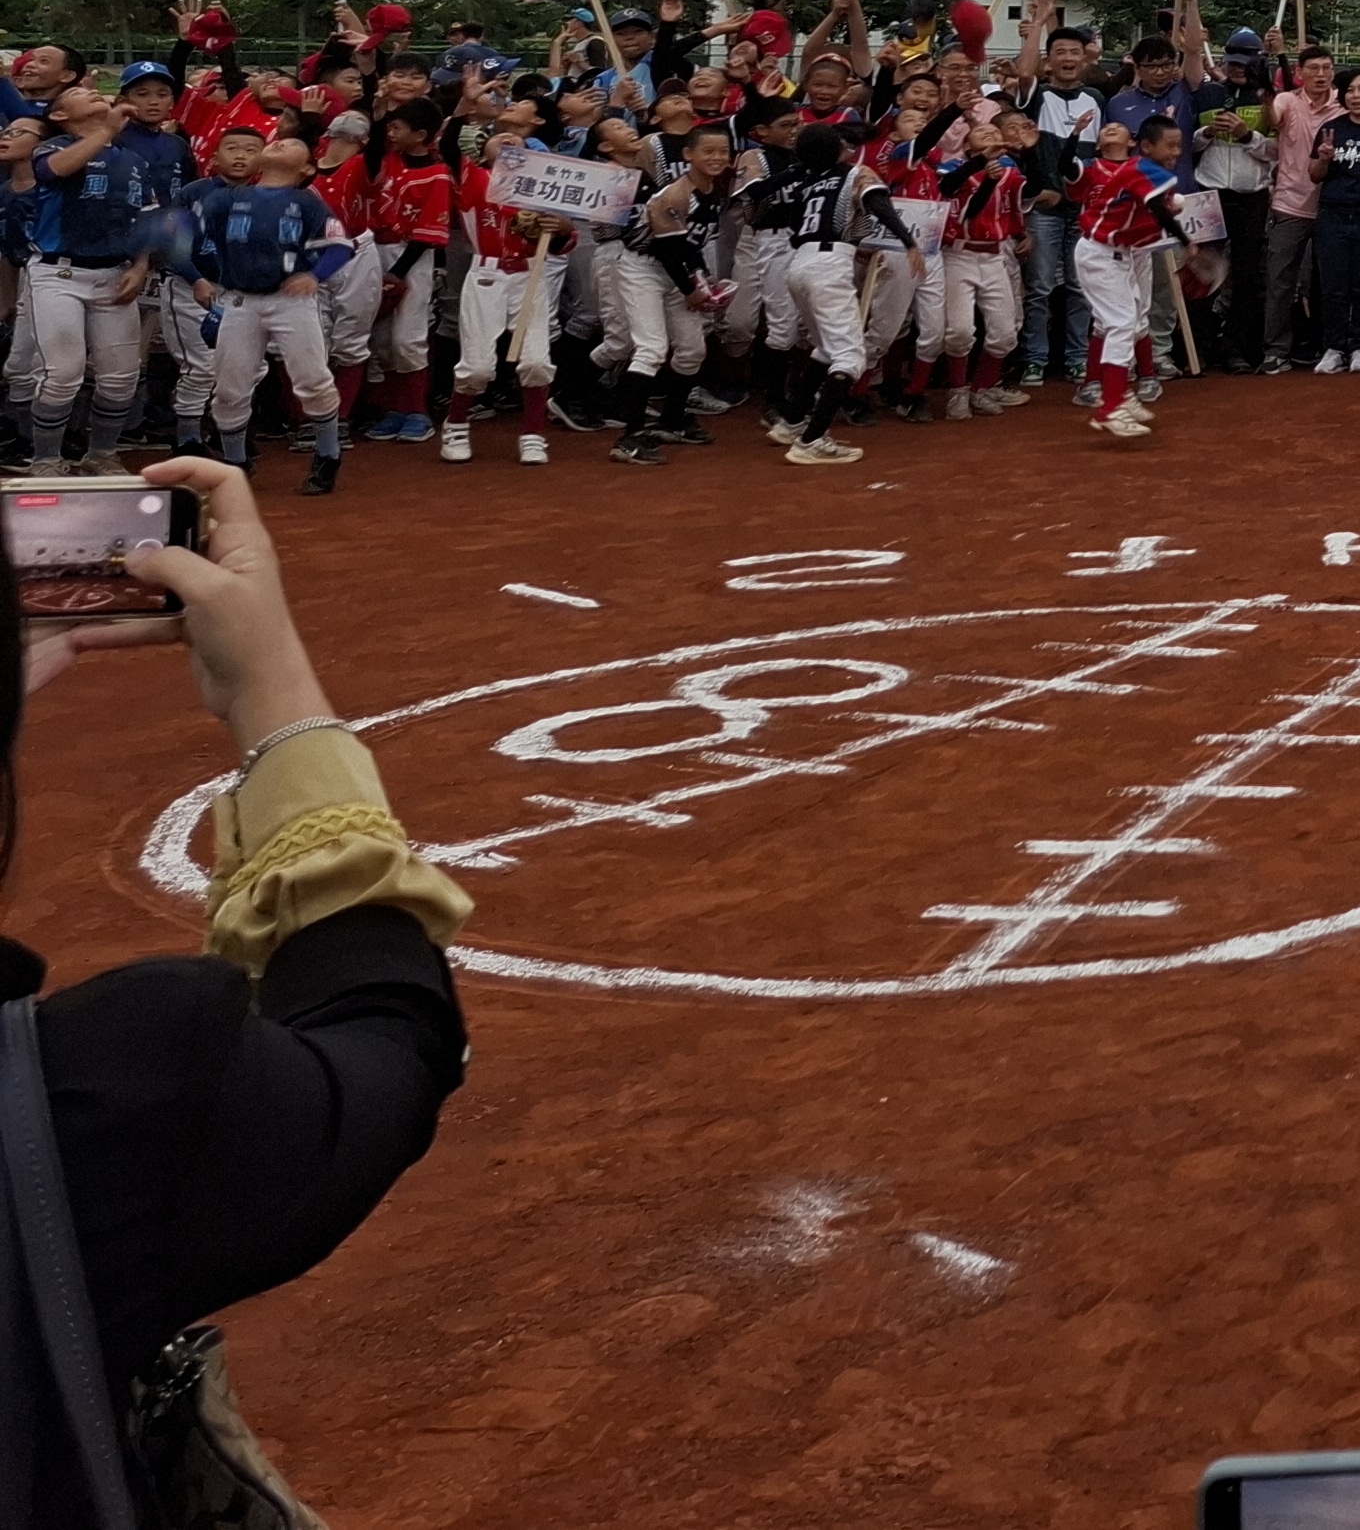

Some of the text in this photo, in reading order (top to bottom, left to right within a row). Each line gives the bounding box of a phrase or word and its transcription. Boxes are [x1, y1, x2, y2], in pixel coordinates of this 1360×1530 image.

[545, 165, 588, 182] 新竹市
[512, 175, 608, 209] 建功國小
